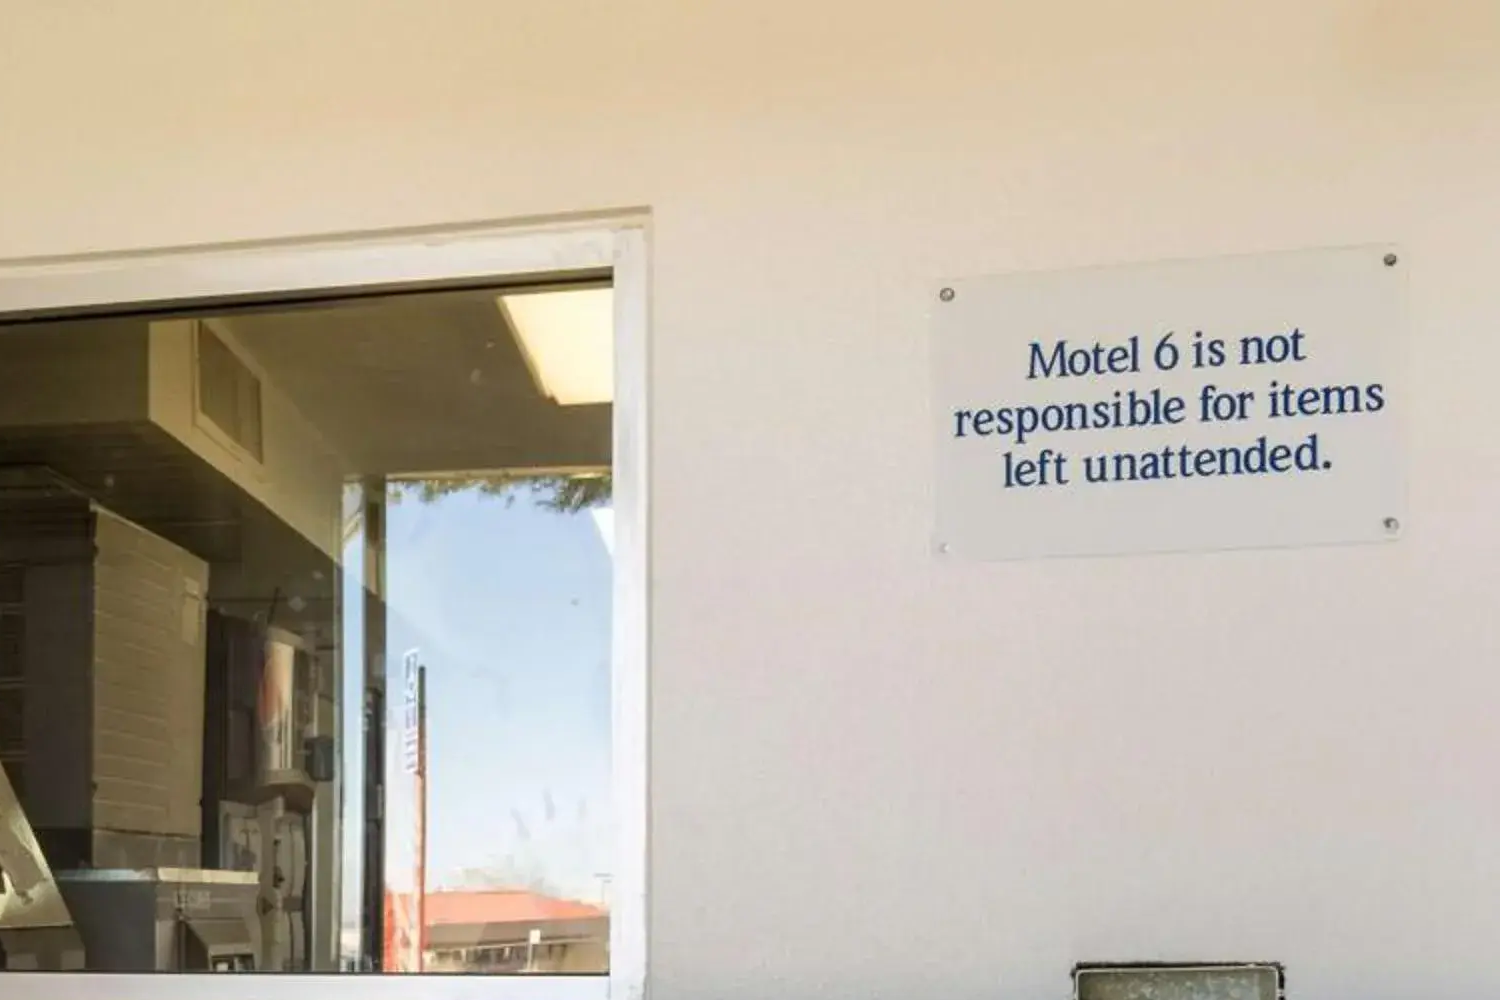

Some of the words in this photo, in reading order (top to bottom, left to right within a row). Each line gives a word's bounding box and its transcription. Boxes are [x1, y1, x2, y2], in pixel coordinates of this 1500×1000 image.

[1025, 336, 1141, 380] Motel
[1153, 331, 1180, 370] 6
[1191, 331, 1226, 369] is
[1239, 327, 1308, 365] not
[953, 388, 1187, 444] responsible
[1199, 384, 1255, 422] for
[1267, 380, 1385, 419] items
[1003, 449, 1070, 489] left
[1084, 433, 1333, 483] unattended.
